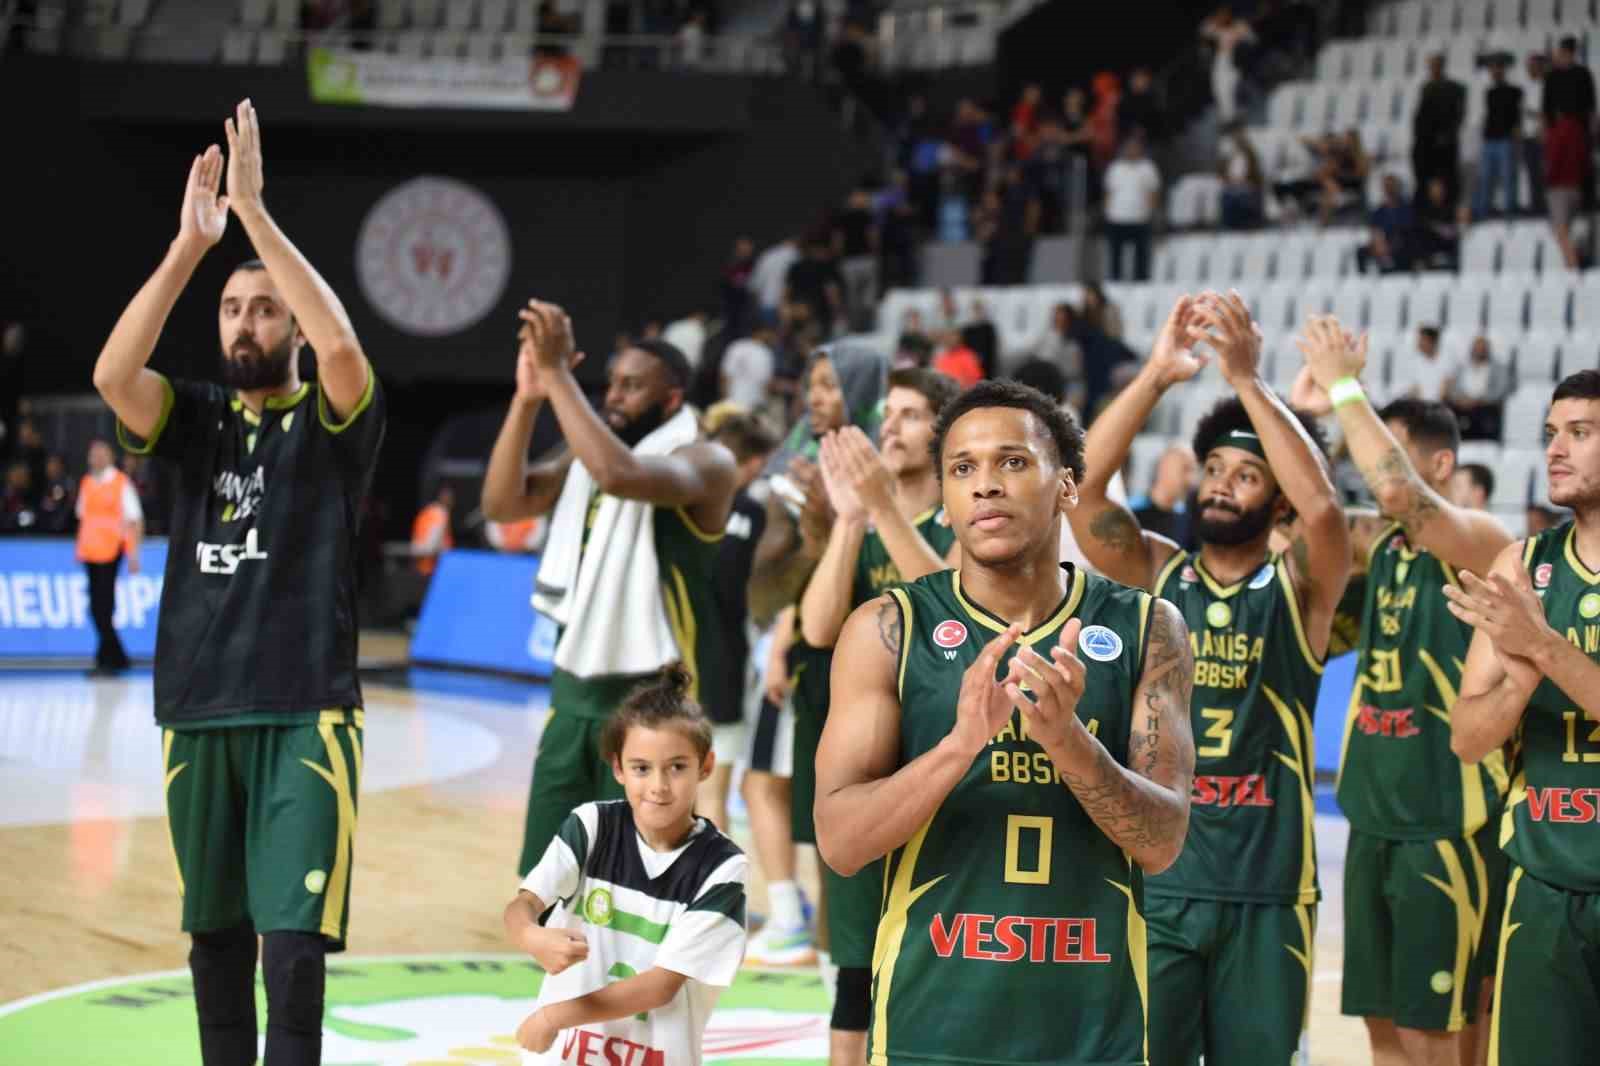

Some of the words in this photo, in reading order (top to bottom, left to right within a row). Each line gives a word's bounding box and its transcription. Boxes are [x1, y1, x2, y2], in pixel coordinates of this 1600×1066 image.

[1193, 660, 1248, 689] BBSK
[1198, 708, 1234, 757] 3
[1004, 814, 1053, 885] 0
[929, 911, 1112, 963] VESTEL
